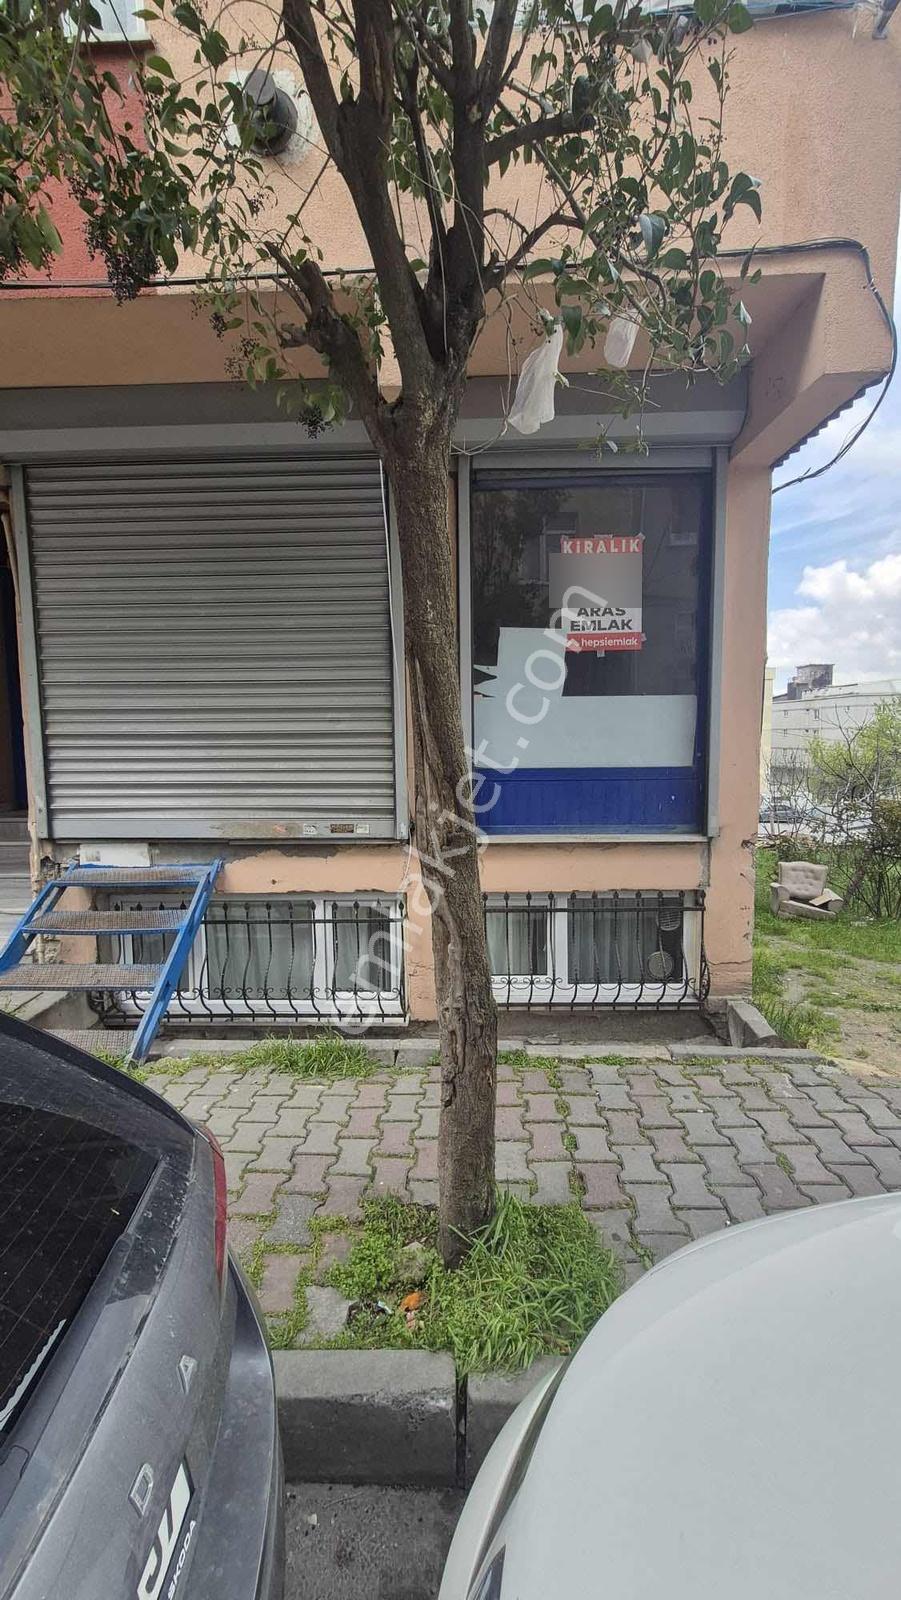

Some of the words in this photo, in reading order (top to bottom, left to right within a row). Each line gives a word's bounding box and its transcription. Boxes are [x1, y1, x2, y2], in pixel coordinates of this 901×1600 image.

[577, 608, 626, 617] ARAS
[570, 619, 633, 632] EMLAK
[581, 637, 639, 648] hepsiemlak
[167, 1520, 197, 1600] SKODA
